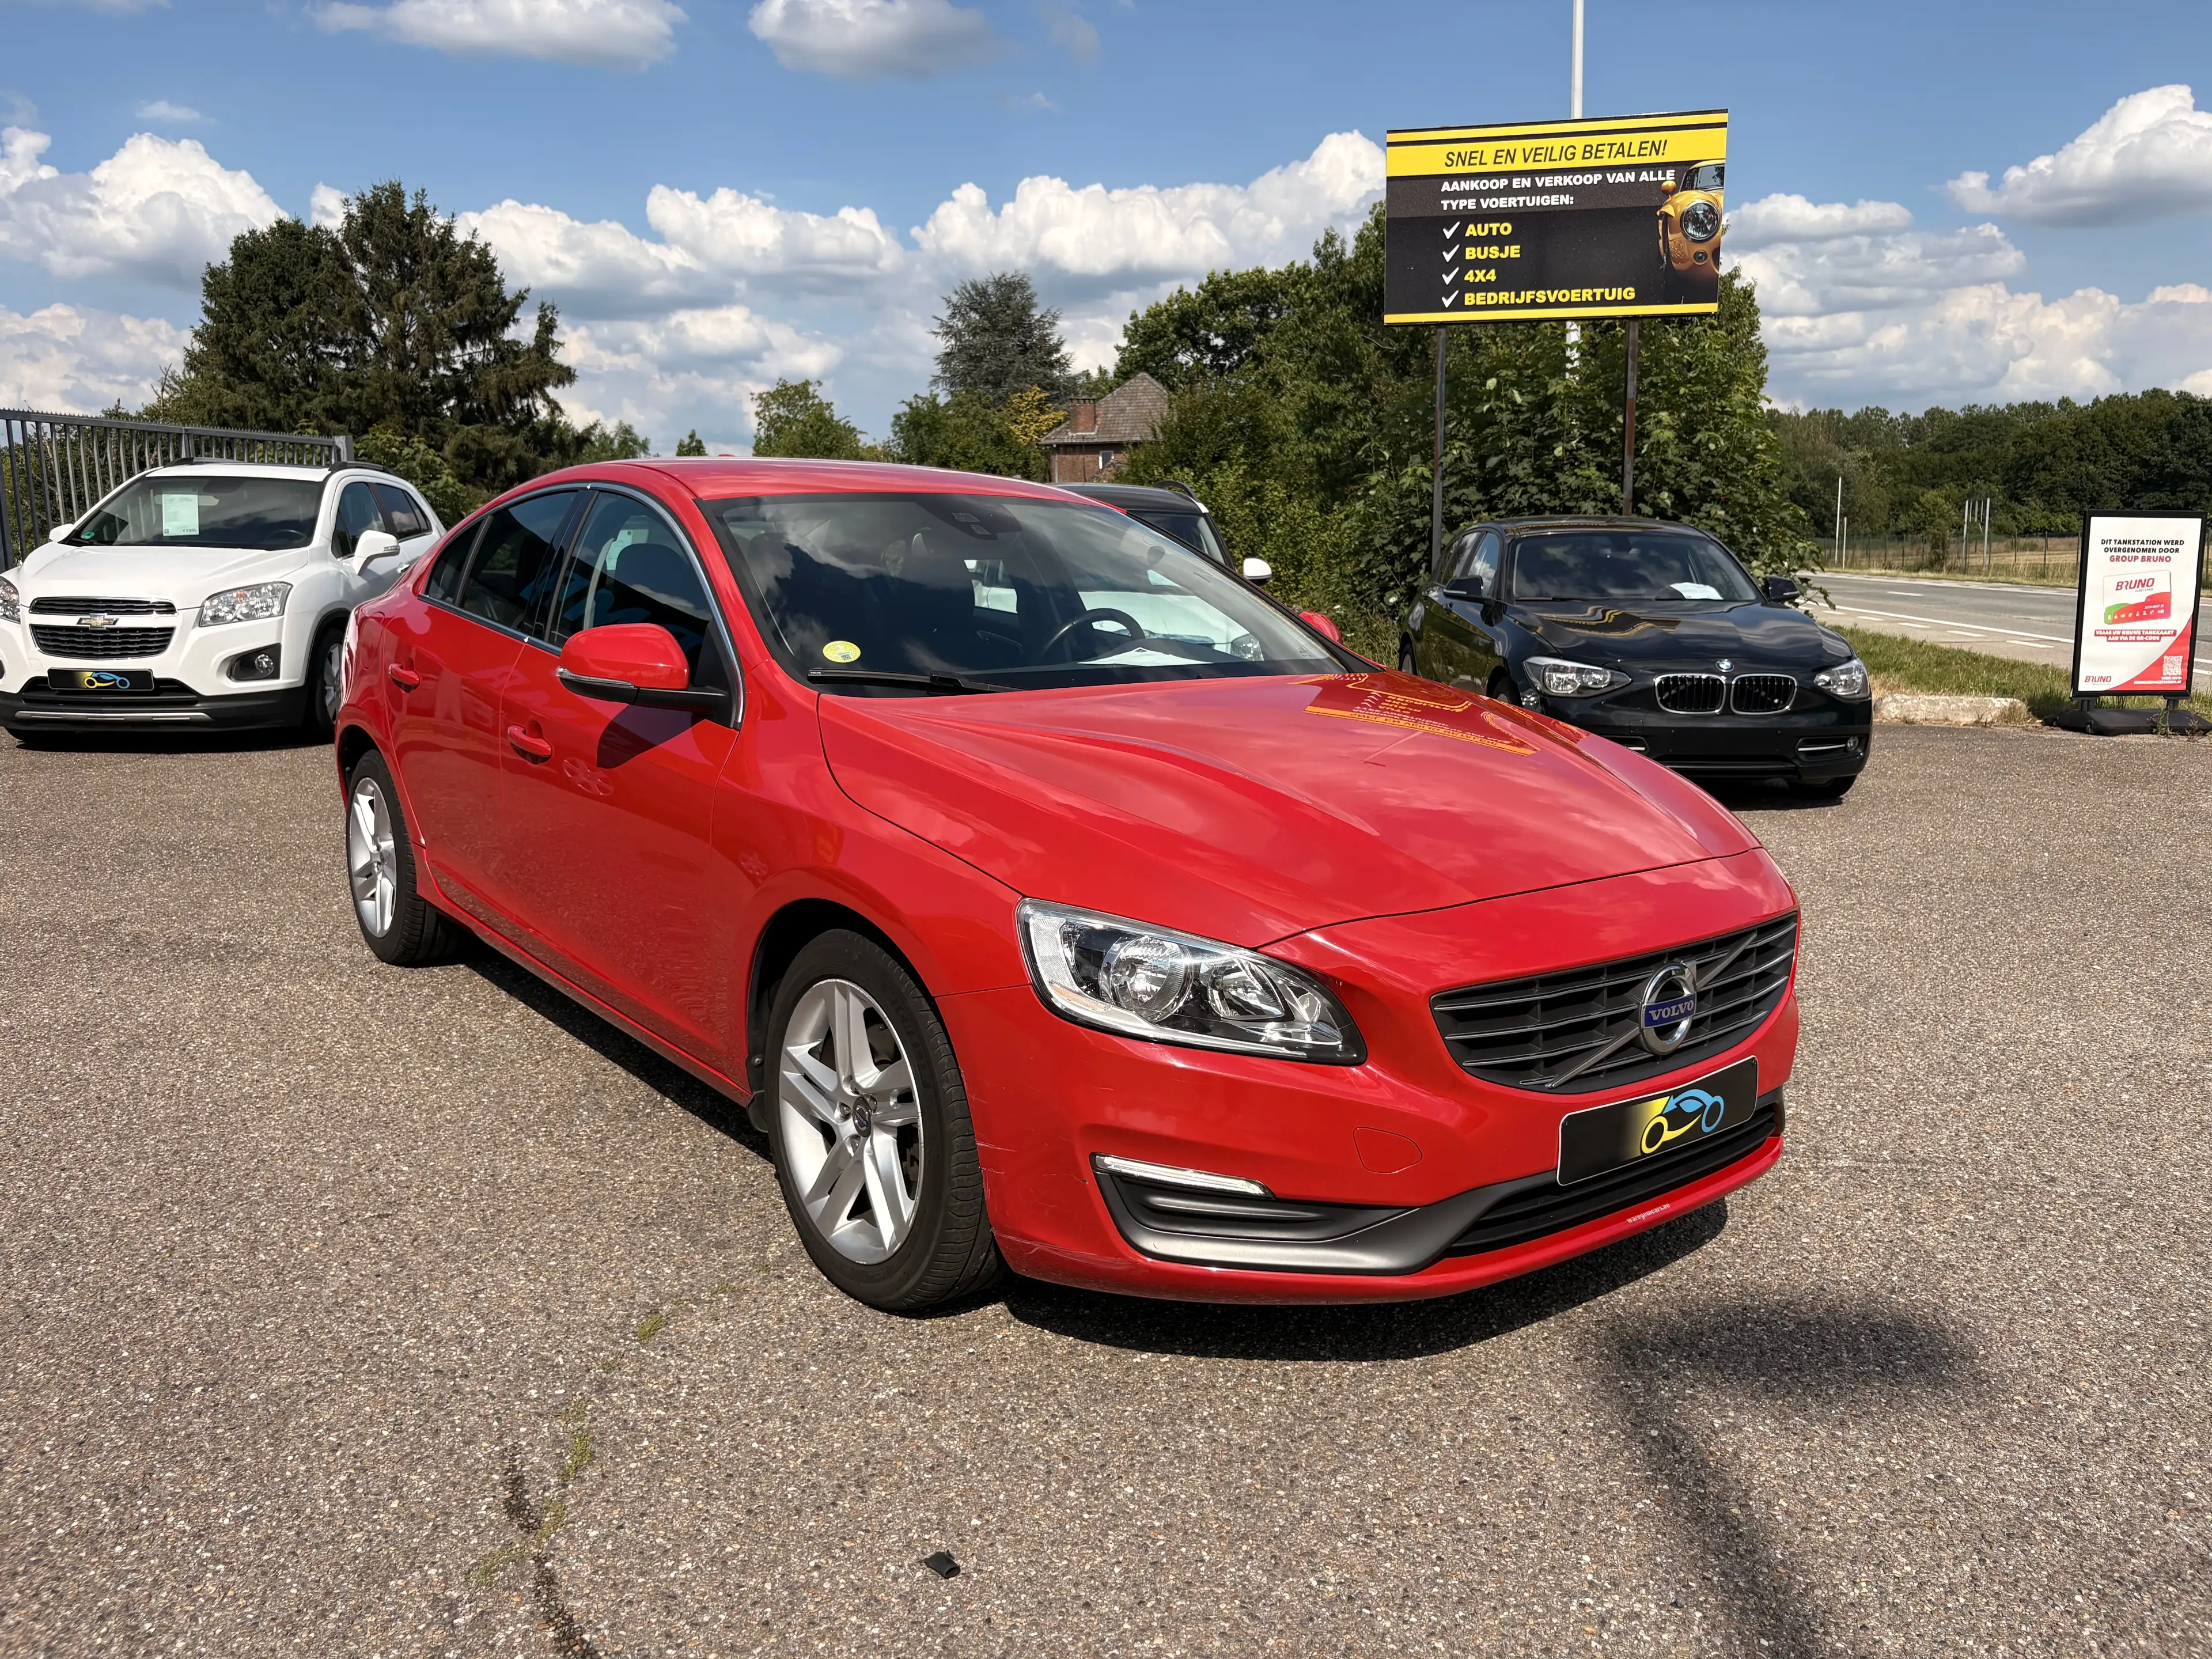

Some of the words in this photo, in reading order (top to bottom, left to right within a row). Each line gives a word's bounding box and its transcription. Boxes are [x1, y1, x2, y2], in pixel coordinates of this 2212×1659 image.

[1444, 150, 1488, 168] SNEL
[1493, 148, 1517, 165] EN
[1522, 145, 1577, 164] VEILIG
[1581, 139, 1668, 160] BETALEN!
[1441, 179, 1509, 192] AANKOOP
[1512, 177, 1531, 188] EN
[1535, 173, 1603, 187] VERKOOP
[1606, 172, 1635, 184] VAN
[1639, 169, 1675, 182] ALLE
[1441, 199, 1476, 211] TYPE
[1480, 194, 1574, 209] VOERTUIGEN:
[1465, 222, 1512, 237] AUTO
[1465, 245, 1521, 260] BUSJE
[1464, 269, 1497, 282] 4X4
[1464, 287, 1635, 306] BEDRIJFSVOERTUIG
[2115, 578, 2155, 591] BRUNO
[1649, 999, 1694, 1021] VOLVO
[1626, 1203, 1671, 1224] waregemcars.be
